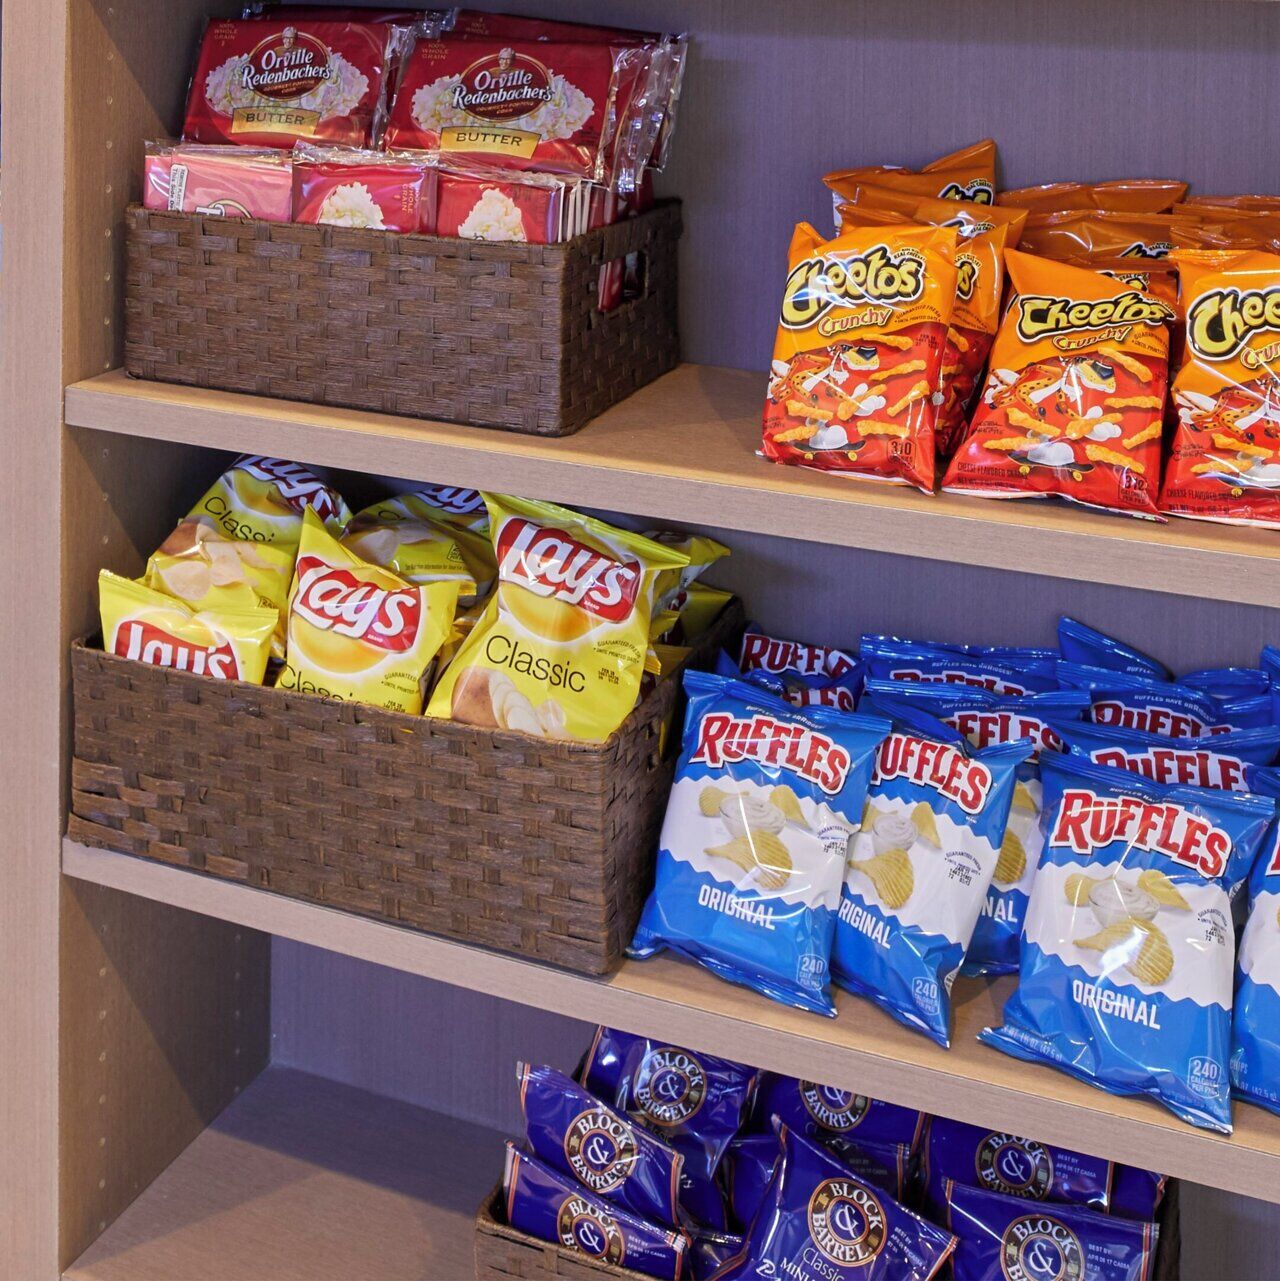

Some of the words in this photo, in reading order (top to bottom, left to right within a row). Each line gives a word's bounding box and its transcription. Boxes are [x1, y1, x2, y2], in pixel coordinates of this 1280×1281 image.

[242, 64, 331, 89] Redenbacher's
[261, 49, 313, 70] Orville
[452, 84, 552, 110] Redenbacher's
[474, 70, 533, 90] Orville
[246, 112, 304, 125] BUTTER
[456, 132, 522, 146] BUTTER
[782, 245, 922, 326] Cheetos
[820, 309, 892, 335] Crunchy
[1020, 292, 1169, 340] Cheetos
[1053, 326, 1132, 349] Crunchy
[891, 441, 912, 455] 310
[204, 496, 275, 543] Classi
[499, 522, 636, 606] Lay's
[486, 634, 586, 692] Classic
[691, 714, 849, 793] RUFFLES
[871, 734, 990, 813] UFFLES
[1053, 790, 1231, 878] RUFFLES
[698, 884, 776, 931] ORIGINAL
[839, 896, 891, 949] RIGINAL
[802, 957, 823, 974] 240
[916, 980, 937, 998] 240
[1073, 979, 1161, 1030] ORIGINAL
[652, 1051, 705, 1087] BLOCK
[1193, 1060, 1217, 1079] 240
[637, 1088, 692, 1120] BARREL
[659, 1075, 680, 1100] &
[804, 1090, 860, 1128] BARREL
[576, 1114, 633, 1150] BLOCK
[989, 1136, 1048, 1163] BLOCK
[587, 1137, 609, 1165] &
[1002, 1150, 1026, 1182] &
[568, 1199, 621, 1239] BLOCK
[829, 1183, 884, 1230] BLOCK
[835, 1204, 859, 1239] &
[812, 1212, 869, 1262] BARREL
[1012, 1219, 1077, 1255] BLOCK
[1029, 1241, 1057, 1277] &
